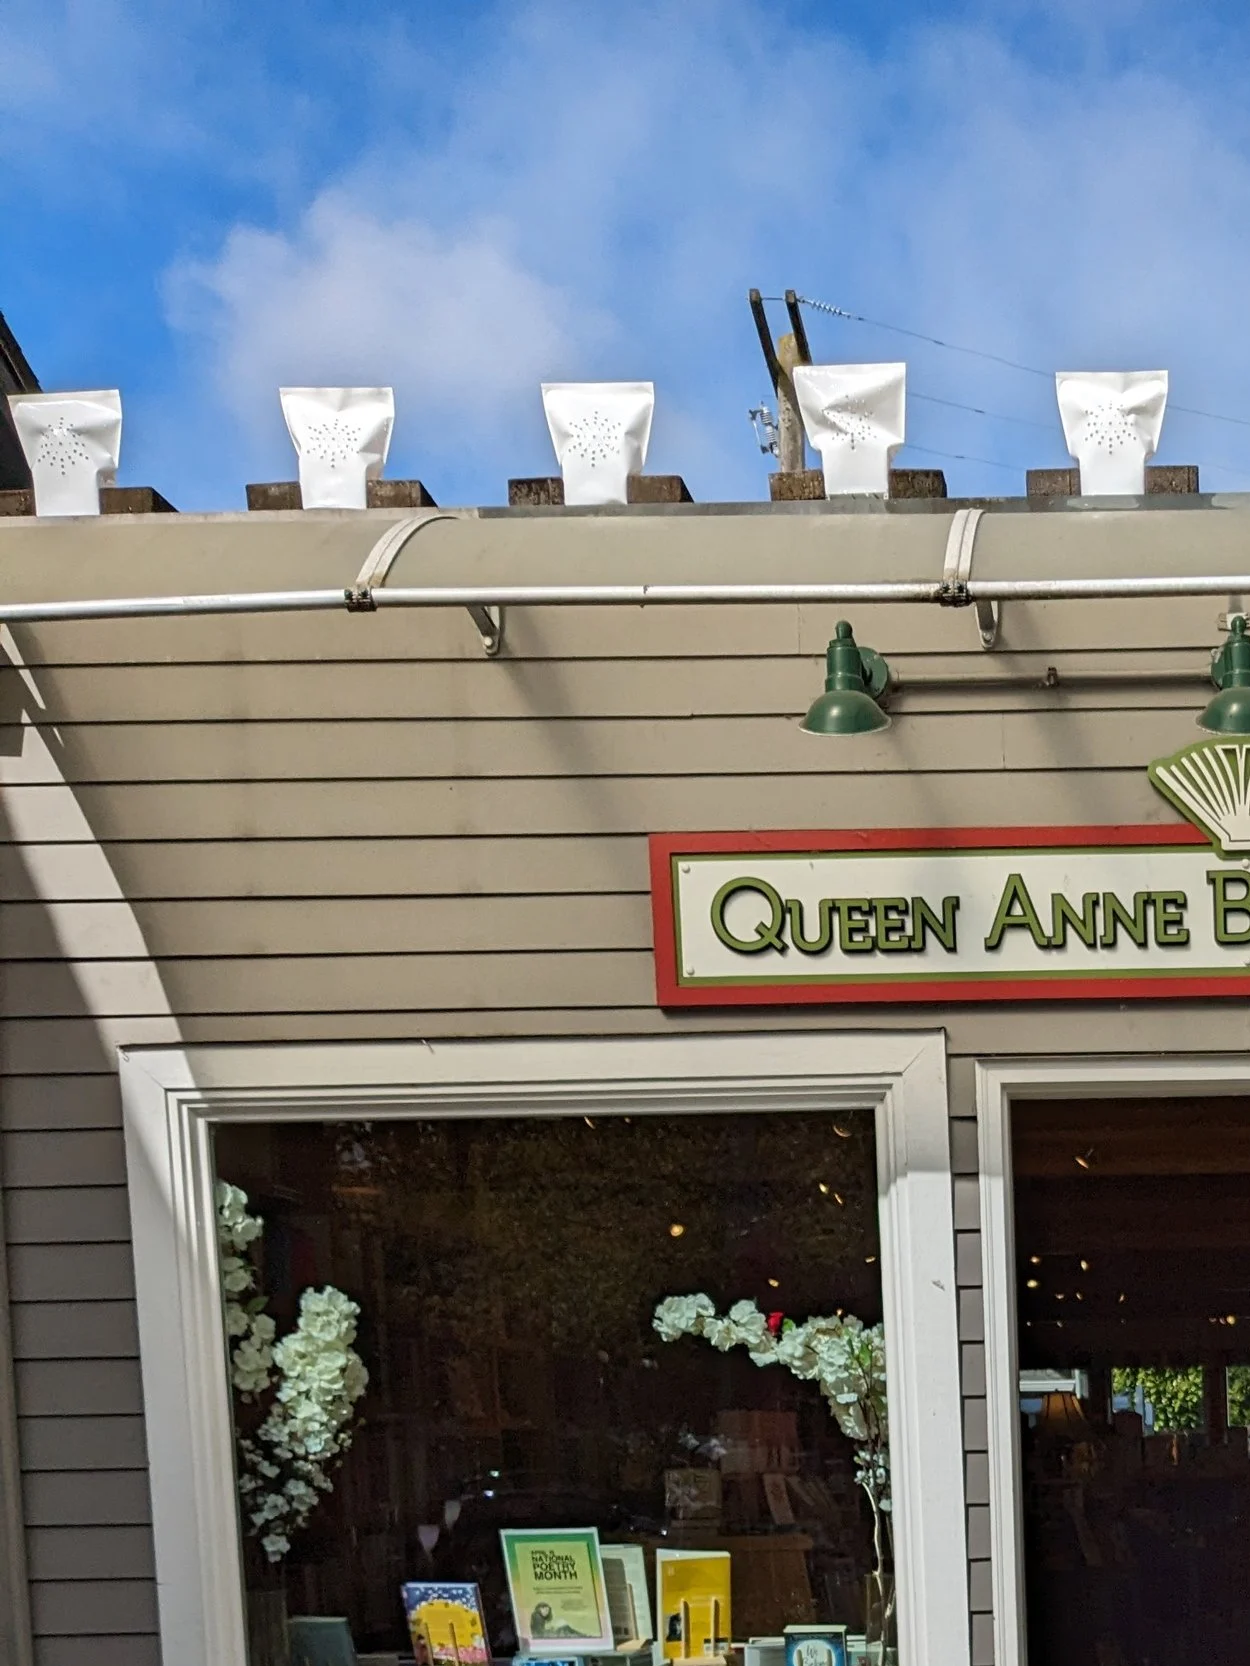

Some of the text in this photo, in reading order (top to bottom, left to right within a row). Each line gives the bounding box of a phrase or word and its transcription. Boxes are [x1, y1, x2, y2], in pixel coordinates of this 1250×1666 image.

[710, 876, 960, 955] QUEEN
[984, 873, 1190, 951] ANNE
[531, 1555, 573, 1563] NATIONAL
[533, 1562, 576, 1572] POETRY
[534, 1571, 578, 1581] MONTH
